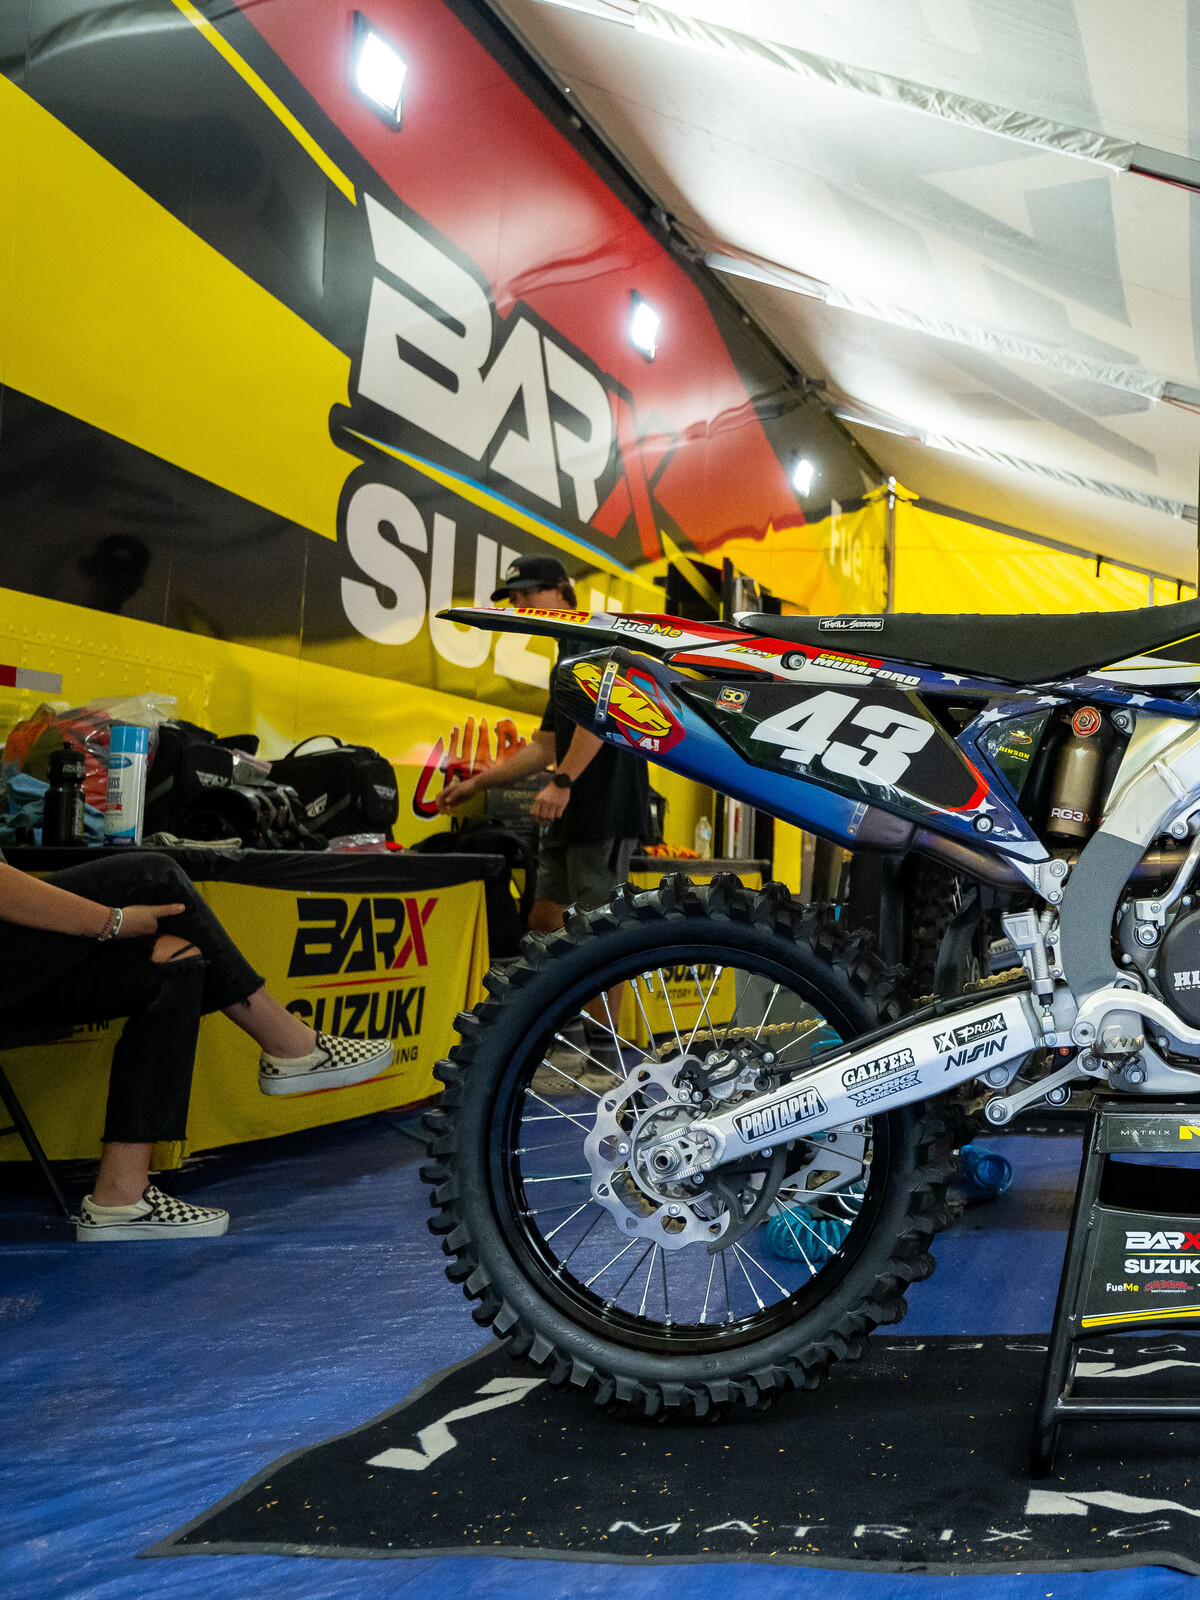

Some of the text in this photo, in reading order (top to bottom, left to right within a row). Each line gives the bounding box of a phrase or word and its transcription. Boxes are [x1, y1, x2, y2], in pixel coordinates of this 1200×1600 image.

[358, 192, 672, 562] BARX
[517, 608, 589, 623] PIRELLI
[611, 617, 682, 638] FuelMe
[812, 657, 921, 686] MUMFORD
[818, 653, 869, 666] CARSON
[723, 689, 745, 703] 50
[750, 691, 935, 786] 43
[999, 746, 1030, 760] HINSON
[1051, 807, 1085, 822] RG3
[287, 897, 439, 978] BARX
[944, 1035, 1008, 1071] NISSIN
[842, 1049, 914, 1087] GALFER
[850, 1073, 918, 1100] WORKS
[857, 1079, 920, 1107] CONNECTION
[741, 1090, 821, 1141] PROTAPER
[1106, 1283, 1139, 1292] FuelMe
[1144, 1280, 1194, 1291] CHAPARRAL
[608, 1519, 1034, 1543] MATRIX
